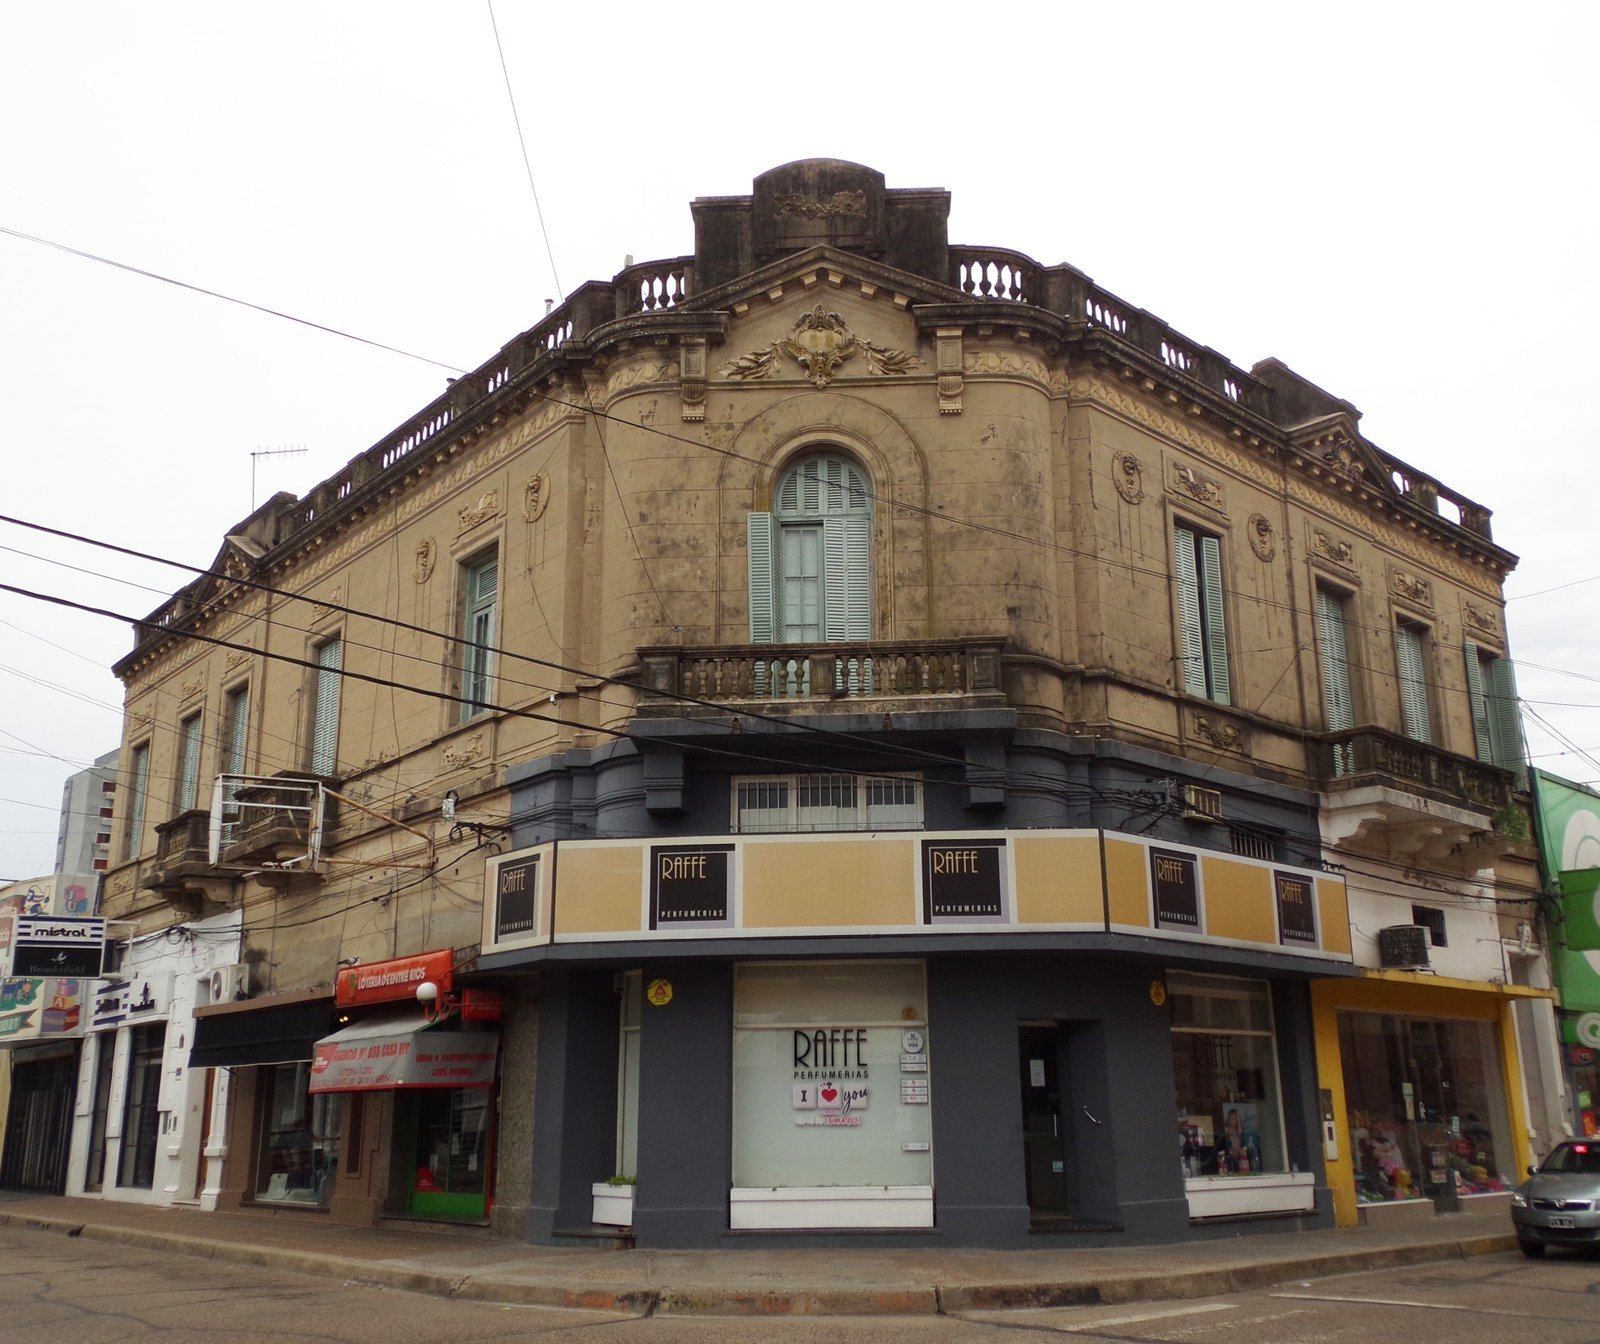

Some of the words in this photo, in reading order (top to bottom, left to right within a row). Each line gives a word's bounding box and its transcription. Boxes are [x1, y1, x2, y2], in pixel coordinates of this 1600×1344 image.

[662, 856, 707, 879] RAFFE
[934, 851, 978, 873] RAFFE
[1157, 858, 1184, 884] RAFFE
[502, 868, 526, 894] RAFFE
[1279, 881, 1304, 904] RAFFE
[661, 909, 723, 918] PERFUMERIAS
[935, 904, 998, 912] PERFUMERIAS
[1160, 911, 1197, 923] PERFUMERIAS
[35, 926, 87, 937] mistral
[501, 920, 532, 932] PERFUMERIAS
[1284, 928, 1314, 939] PERFUMERIAS
[30, 965, 86, 974] Brooksfield
[794, 1029, 868, 1067] RAFFE
[793, 1070, 869, 1080] PERFUMERIAS
[801, 1090, 807, 1102] I
[842, 1087, 870, 1115] you
